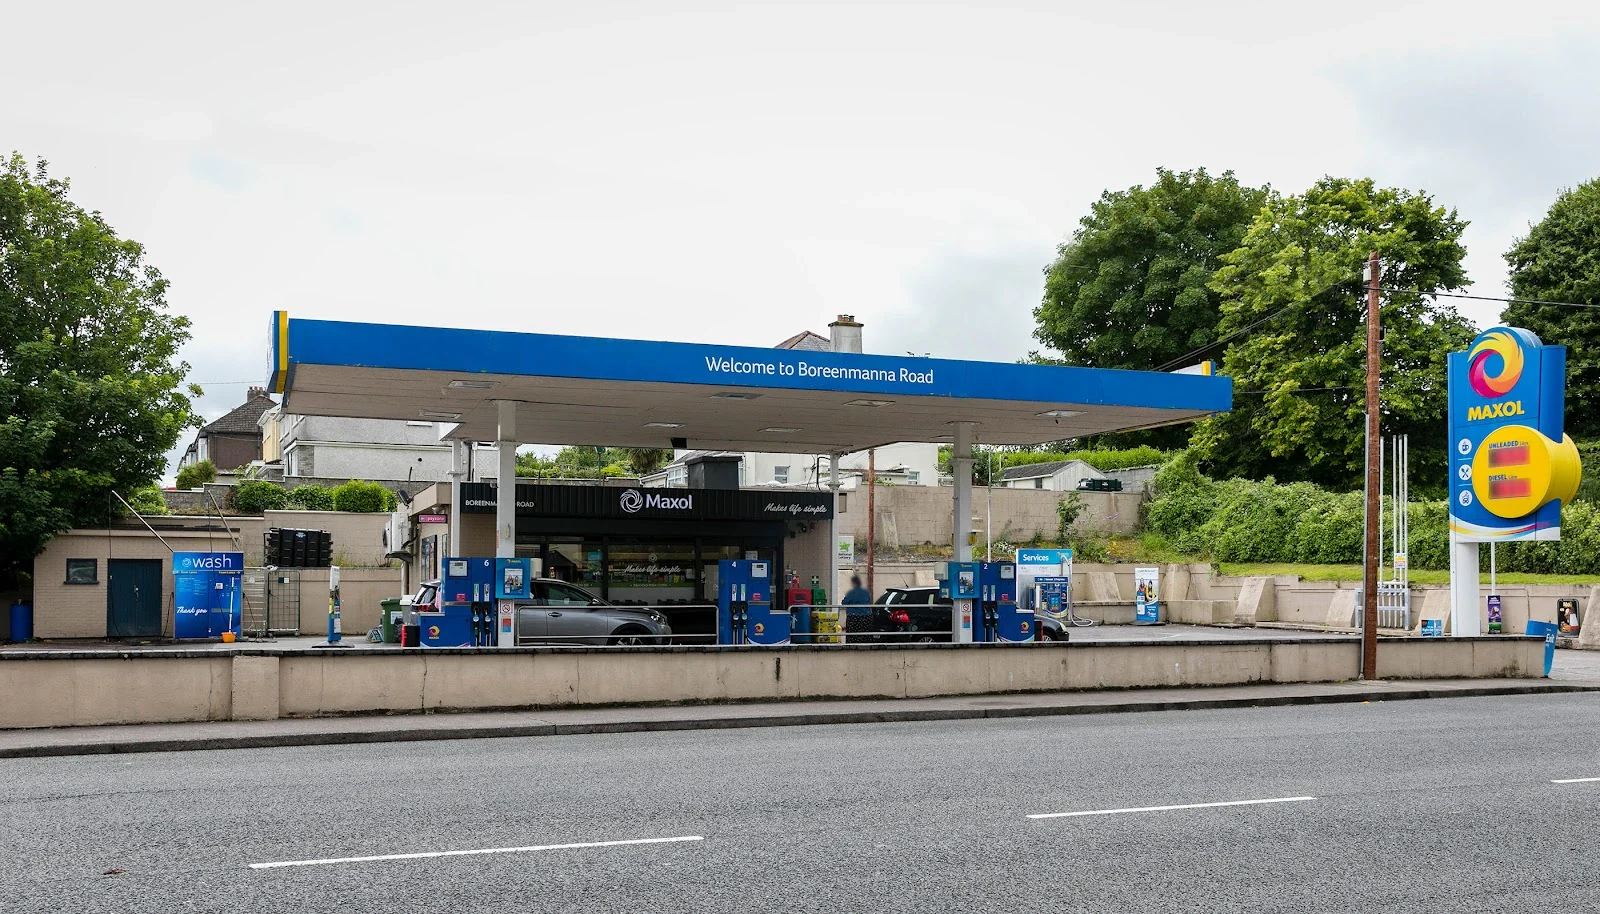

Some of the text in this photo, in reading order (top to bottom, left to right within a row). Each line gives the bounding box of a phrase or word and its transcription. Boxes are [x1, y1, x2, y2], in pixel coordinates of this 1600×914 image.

[705, 356, 934, 384] Welcome to Boreenmanna Road
[1468, 401, 1525, 421] MAXOL
[1488, 440, 1518, 449] UNLEADED
[465, 499, 497, 507] BOREENM
[645, 493, 693, 510] Maxol
[764, 503, 827, 516] Makes life simple
[193, 554, 232, 568] wash
[484, 559, 490, 567] 6
[1022, 553, 1049, 562] Services
[624, 565, 645, 573] Makes
[659, 565, 681, 575] simple
[177, 606, 208, 617] Thank you
[1545, 633, 1555, 644] Exit
